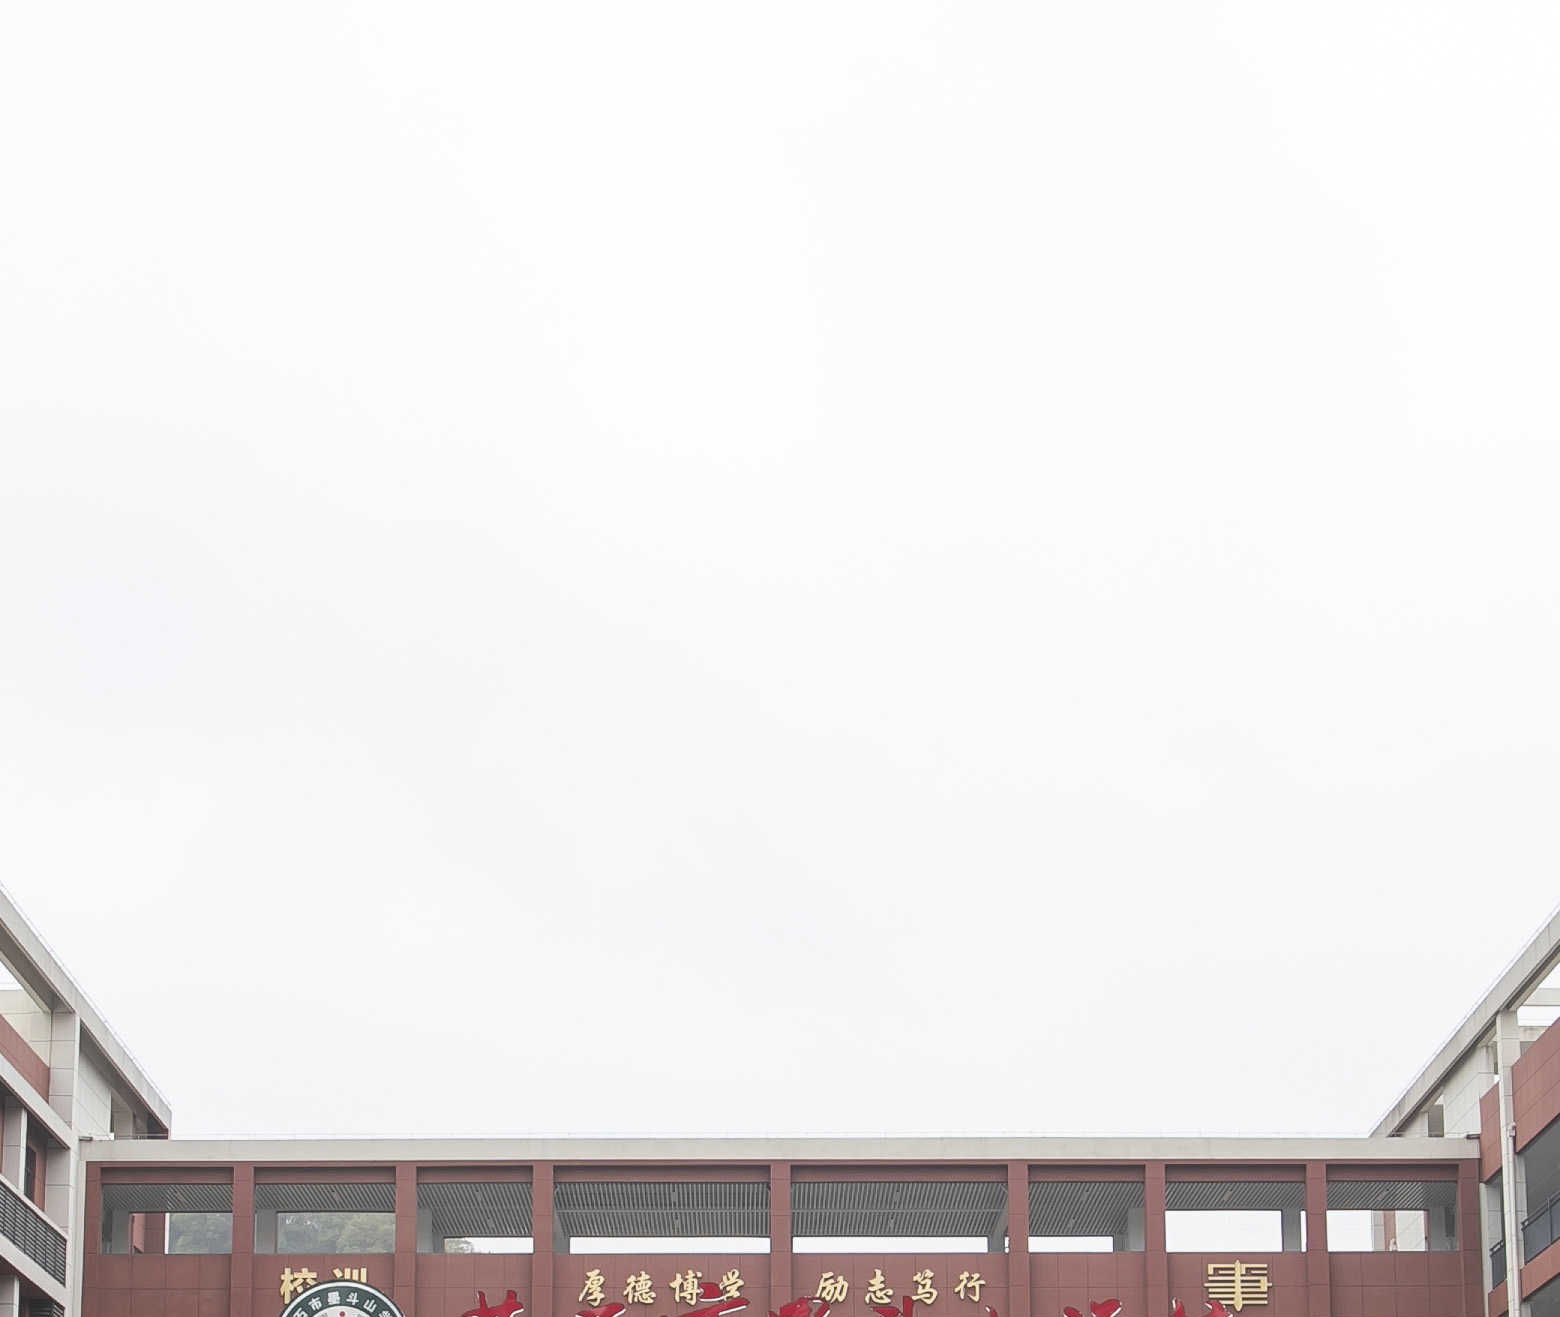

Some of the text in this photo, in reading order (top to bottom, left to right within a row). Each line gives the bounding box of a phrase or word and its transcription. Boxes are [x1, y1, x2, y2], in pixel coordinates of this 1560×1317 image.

[578, 1268, 987, 1306] 厚德博学 励志笃行
